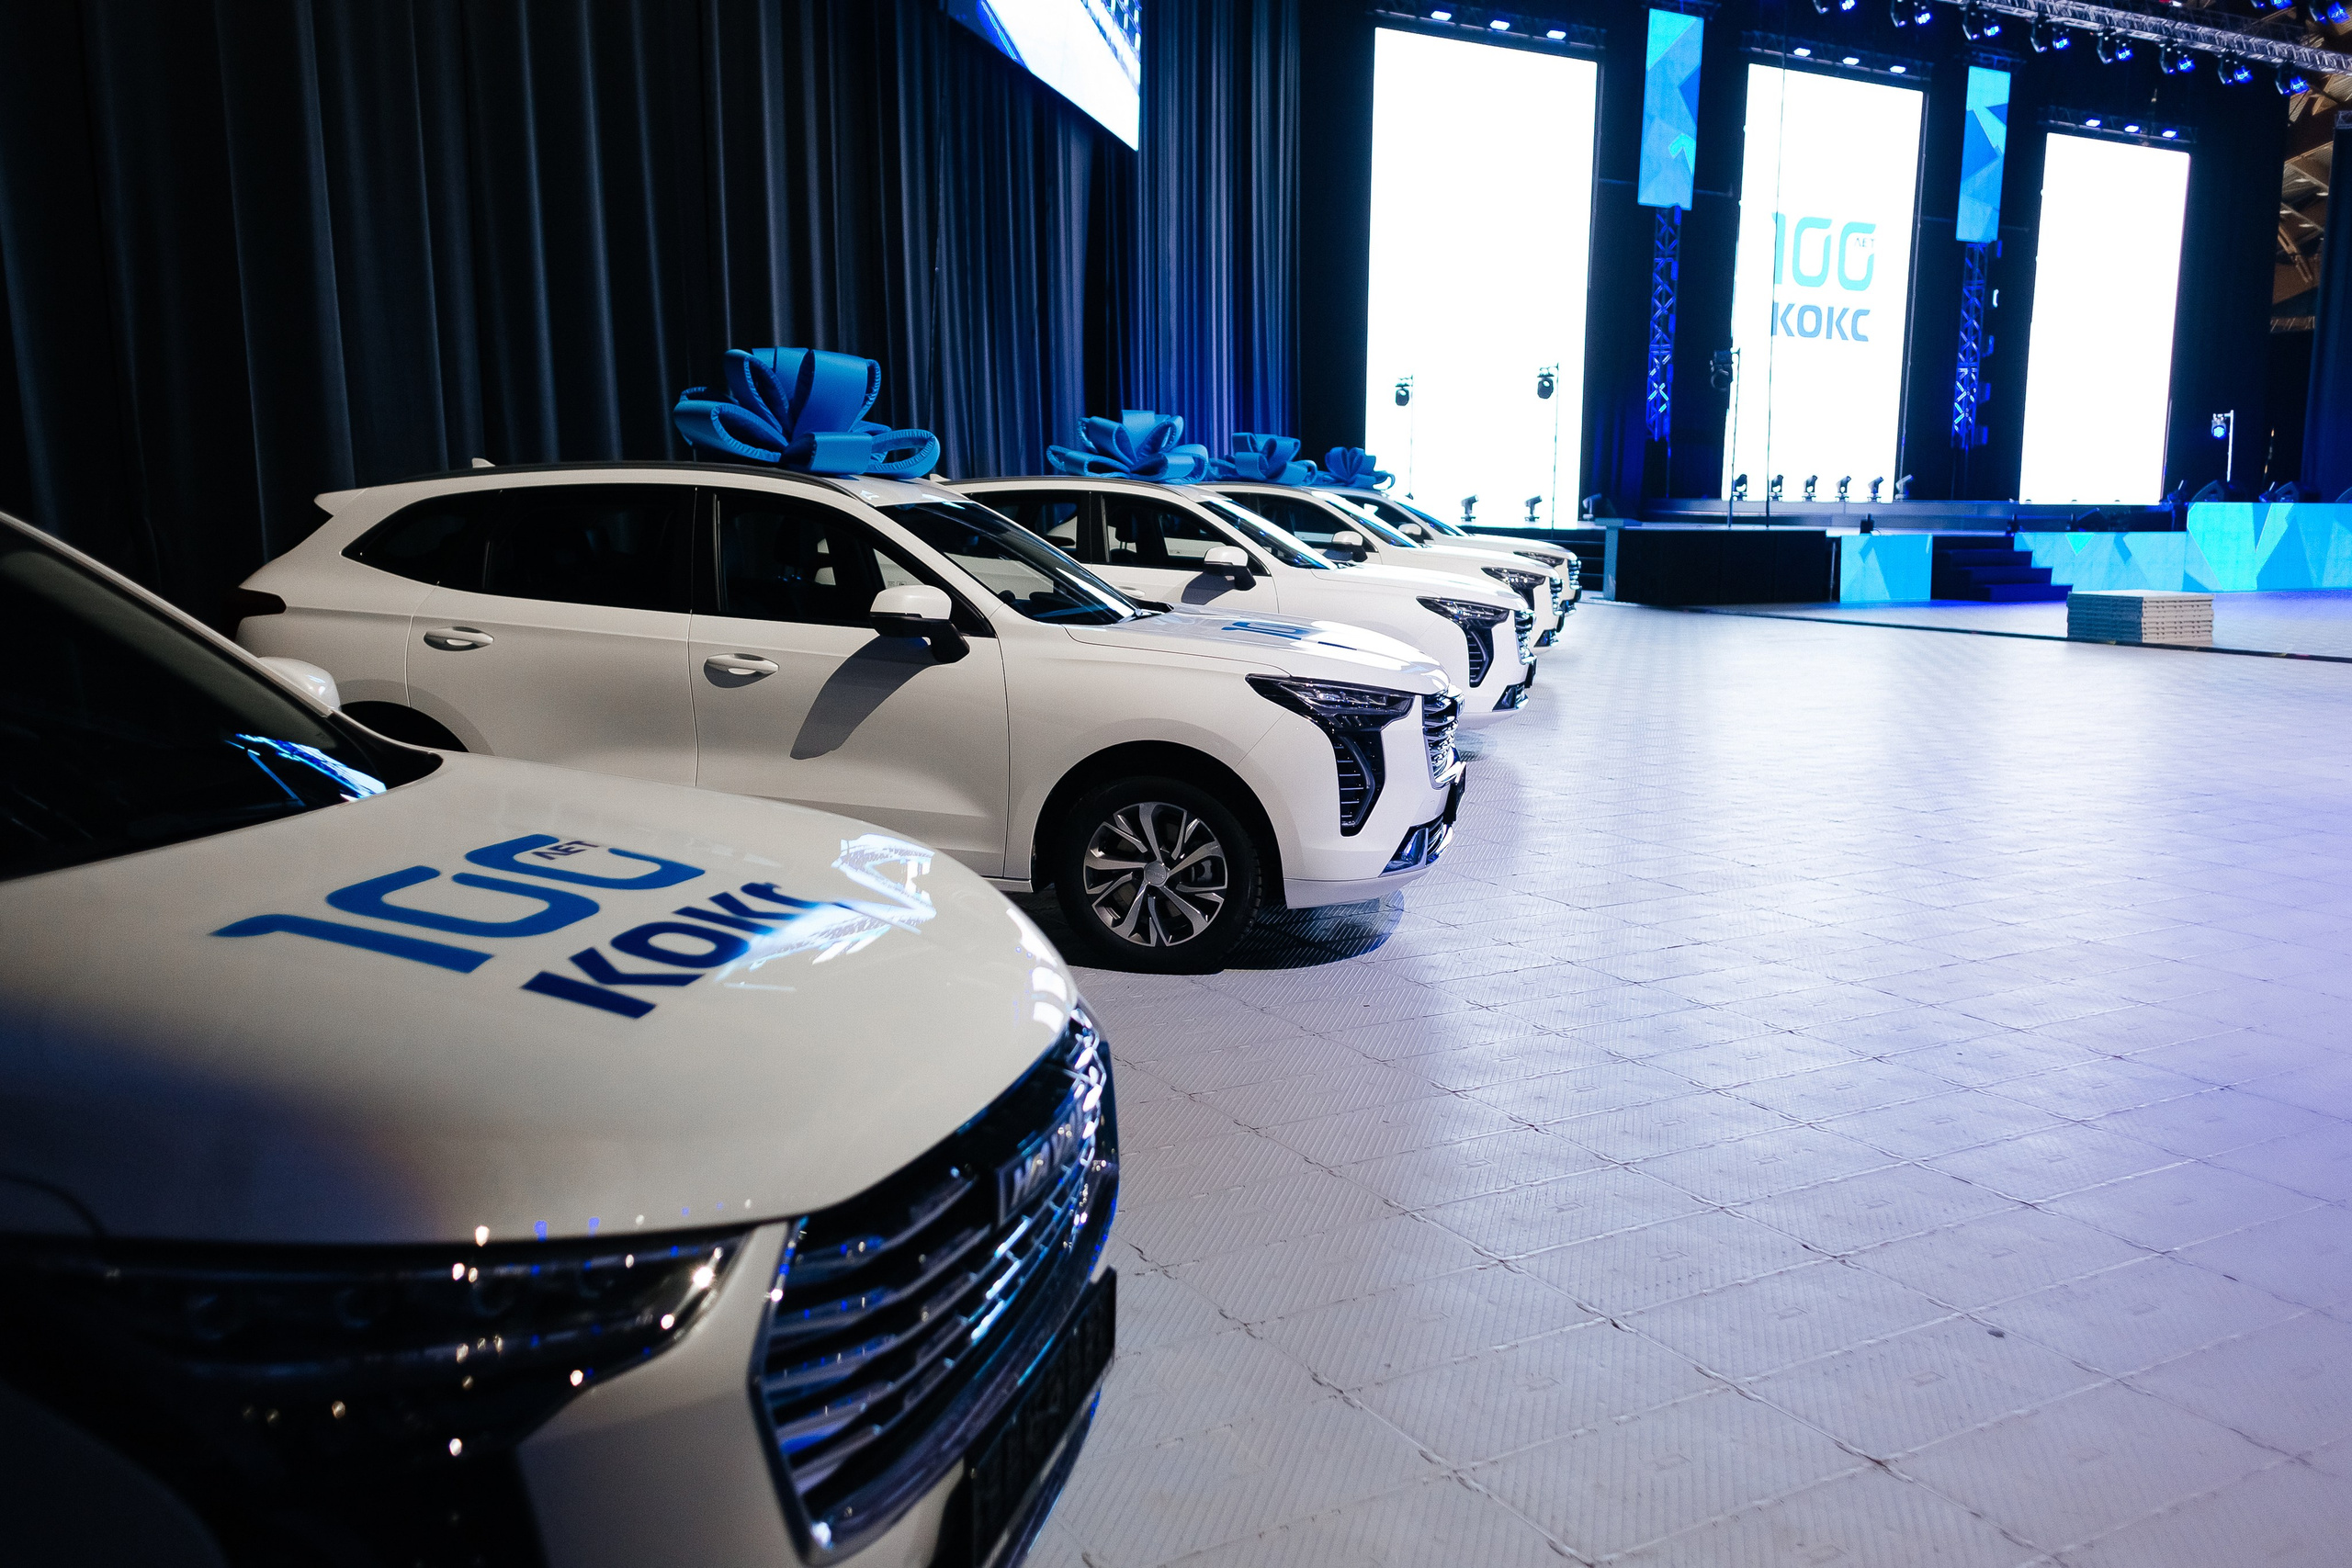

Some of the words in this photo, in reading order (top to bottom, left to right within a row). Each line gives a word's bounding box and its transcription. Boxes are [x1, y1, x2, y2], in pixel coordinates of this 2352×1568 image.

[1771, 212, 1876, 291] 100
[1771, 301, 1871, 343] КОКС
[208, 834, 706, 975] 100
[531, 840, 600, 861] ЛЕТ
